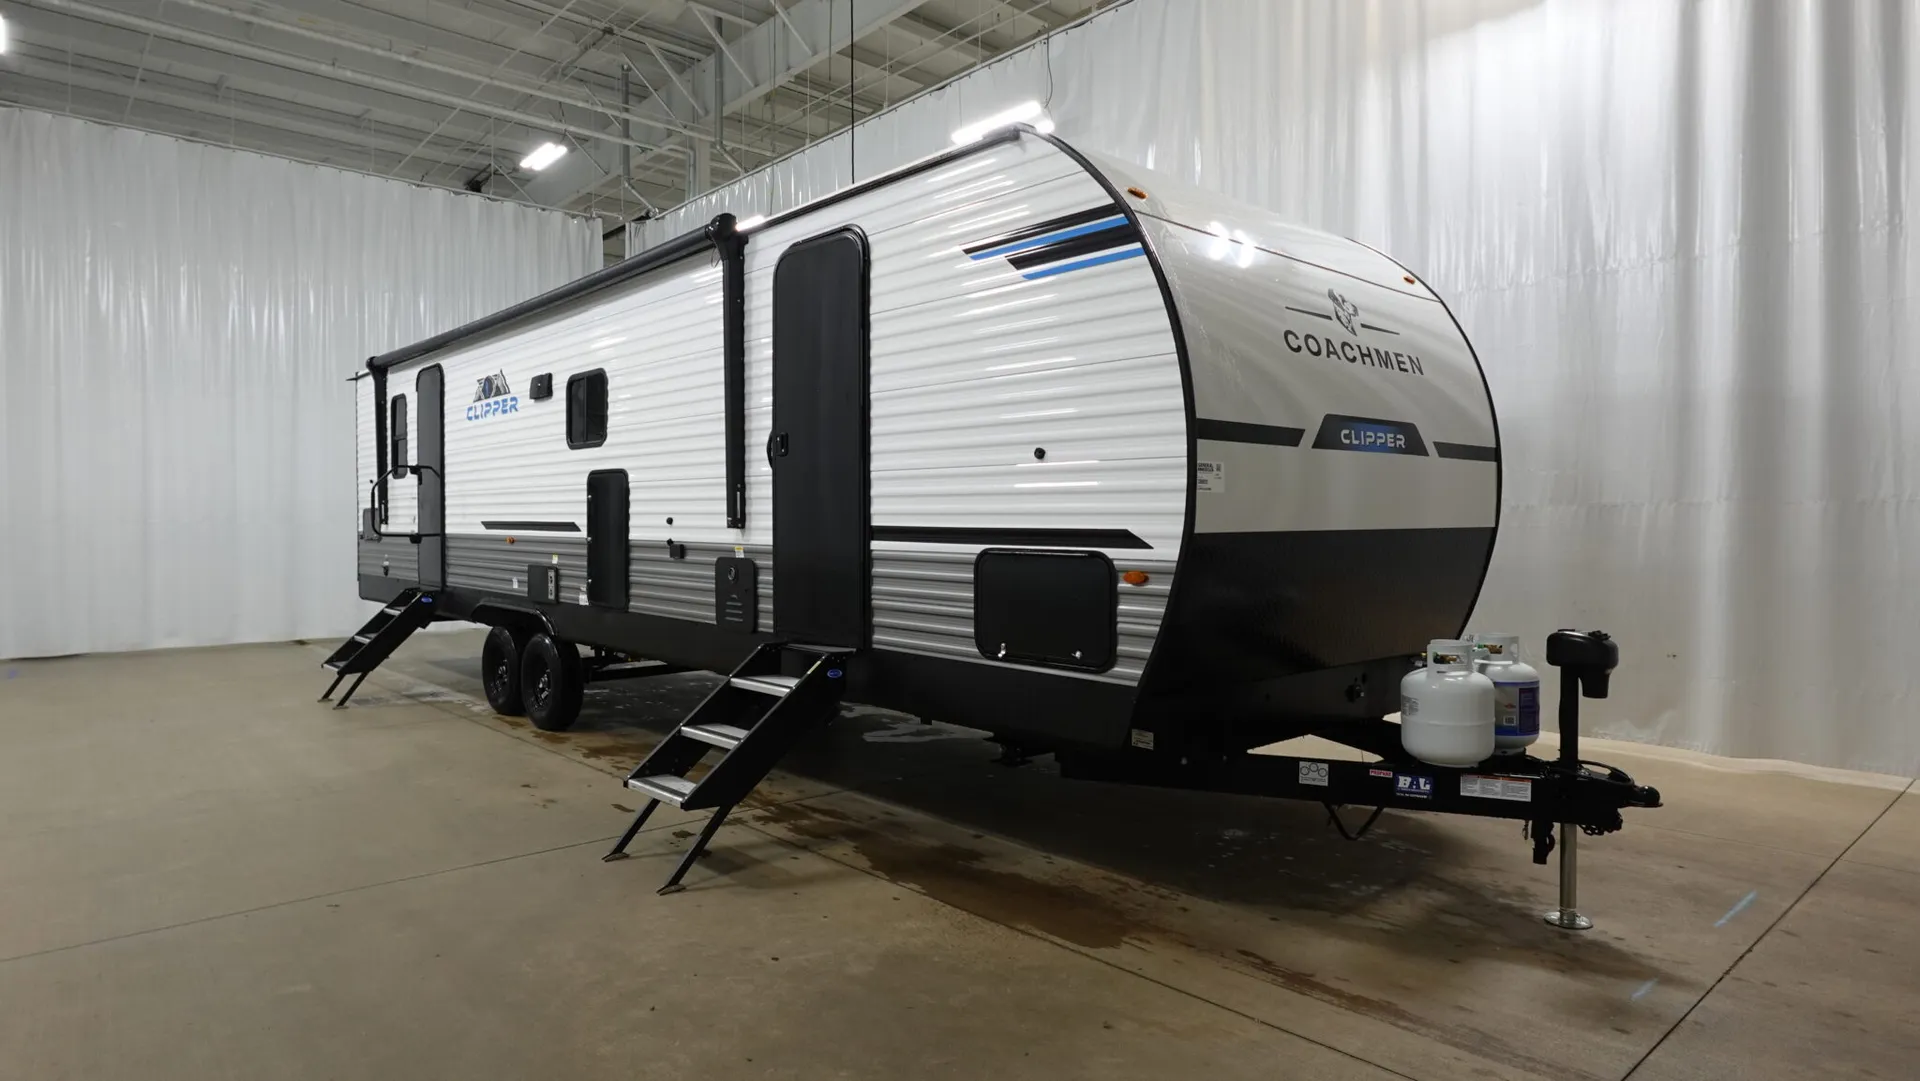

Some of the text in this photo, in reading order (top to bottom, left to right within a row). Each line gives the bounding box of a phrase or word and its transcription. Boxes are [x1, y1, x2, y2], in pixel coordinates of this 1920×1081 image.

[1283, 329, 1425, 376] COACHMEN
[466, 396, 519, 421] CLIPPER
[1340, 429, 1407, 449] CLIPPER
